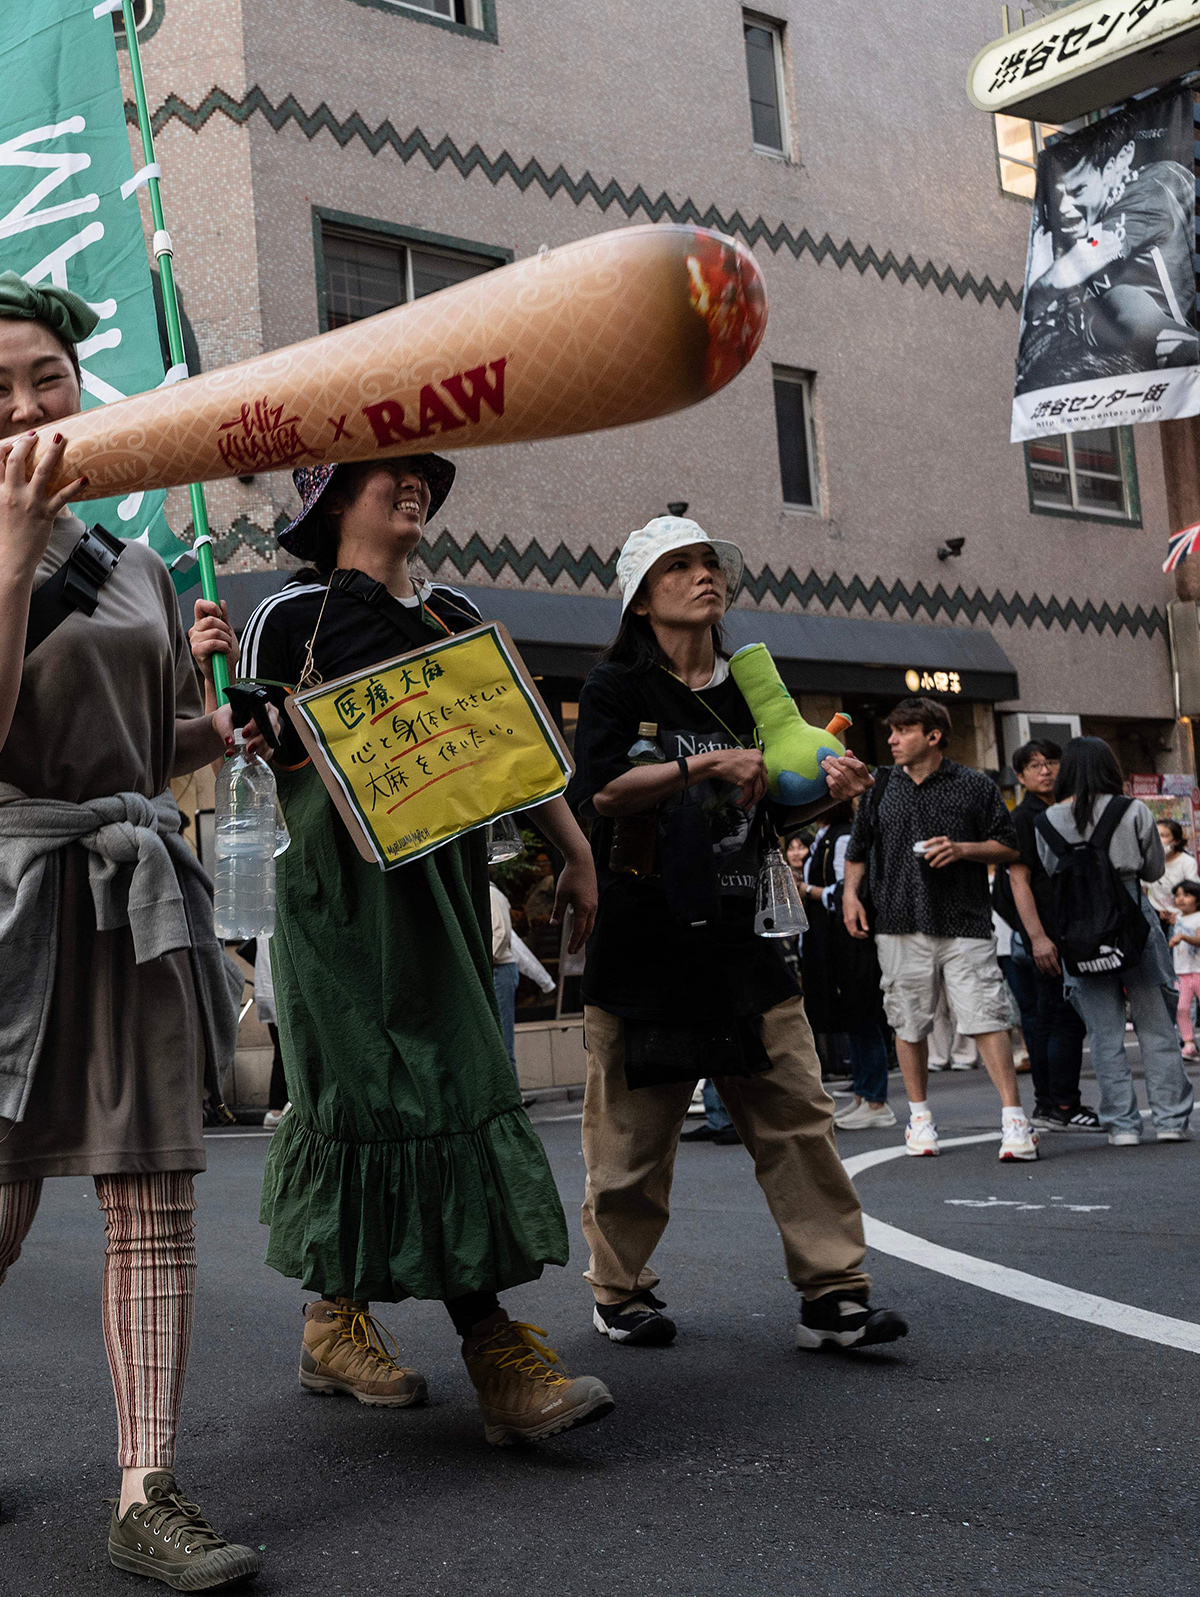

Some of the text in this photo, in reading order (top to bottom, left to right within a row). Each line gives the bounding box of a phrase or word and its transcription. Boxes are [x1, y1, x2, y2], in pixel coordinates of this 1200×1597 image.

[362, 357, 508, 448] RAW
[1030, 382, 1170, 420] 渋谷センター街
[1077, 953, 1122, 973] PUMA
